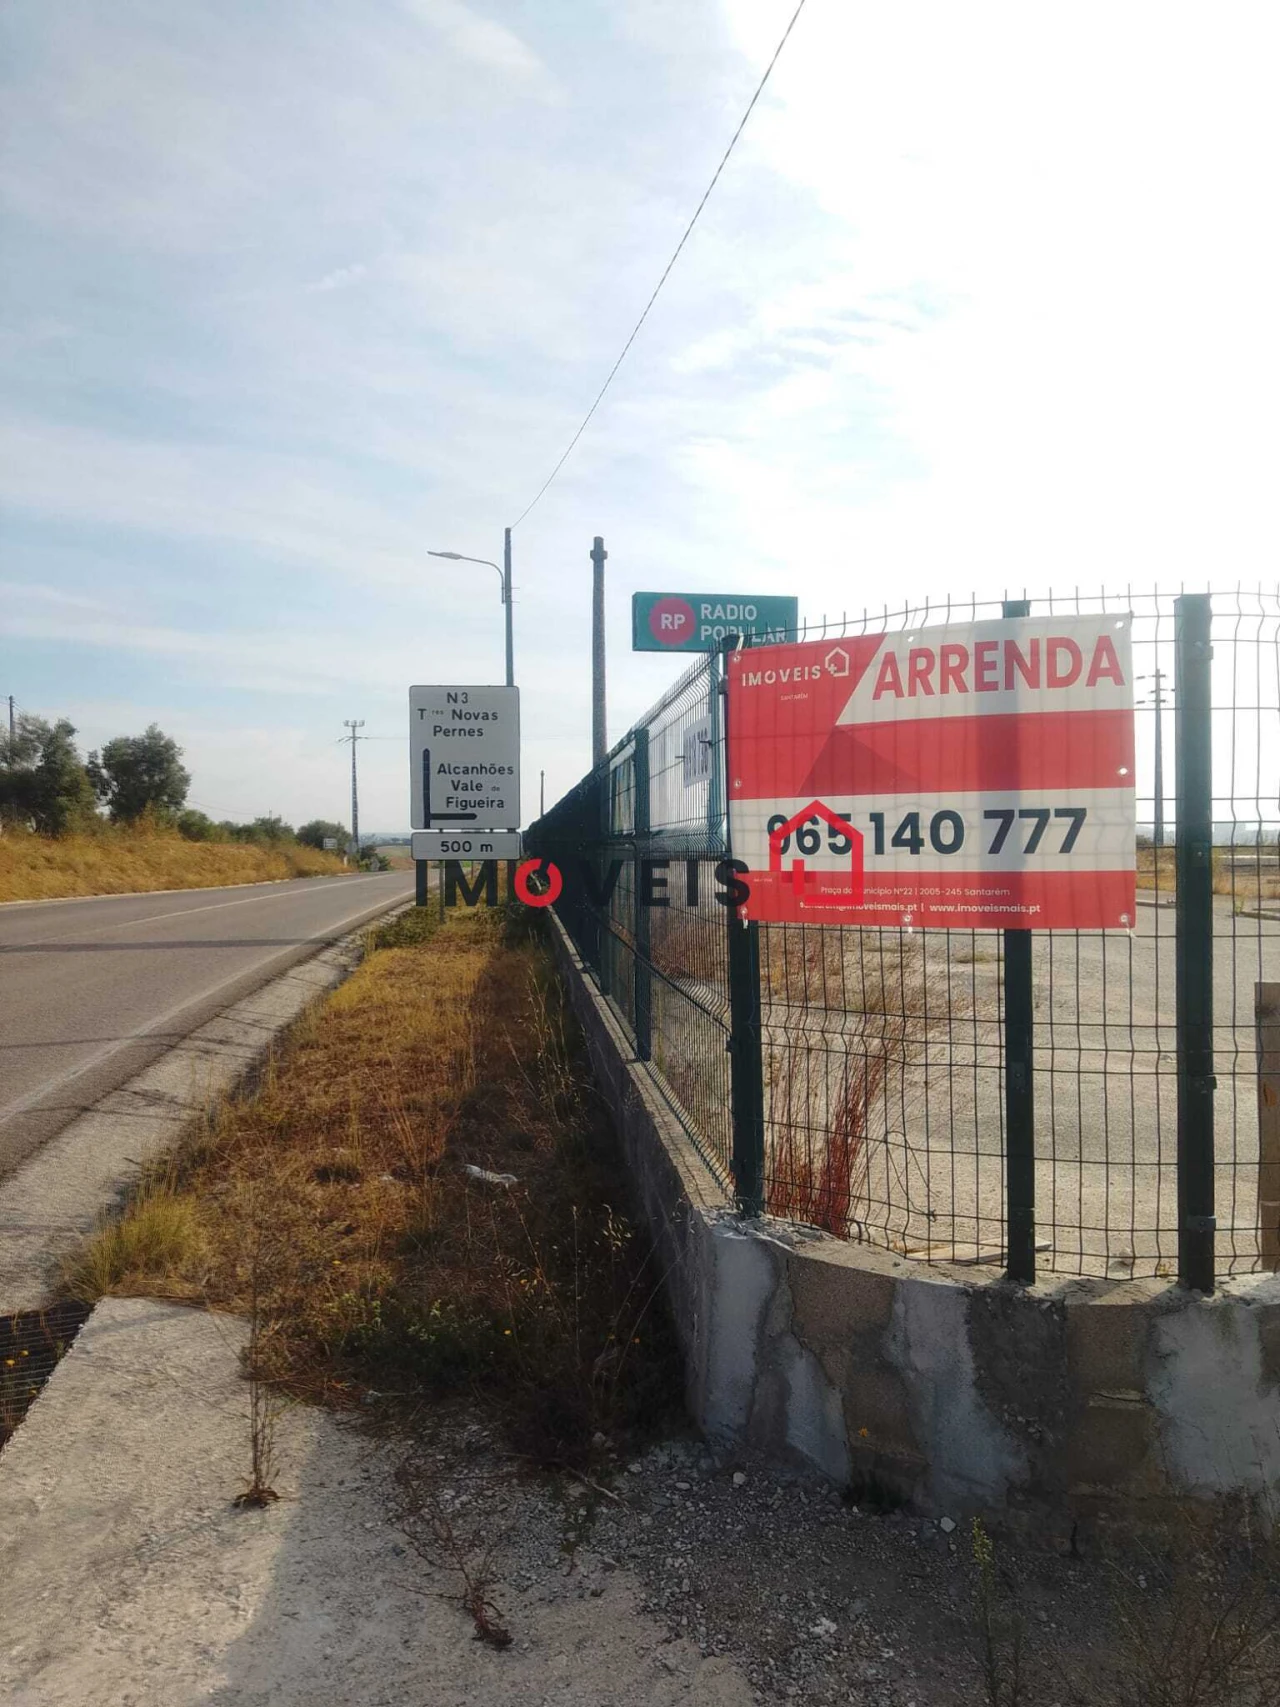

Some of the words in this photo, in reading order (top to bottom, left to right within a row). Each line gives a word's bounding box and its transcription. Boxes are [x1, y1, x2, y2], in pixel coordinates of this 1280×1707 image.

[700, 603, 758, 621] RADIO
[660, 613, 686, 630] RP
[872, 635, 1126, 701] ARRENDA
[741, 665, 821, 687] IMOVEIS
[451, 708, 499, 721] Novas
[433, 724, 484, 737] Pernes
[436, 762, 514, 775] Alcanhões
[451, 779, 484, 792] Vale
[445, 796, 505, 811] Figueira
[766, 813, 854, 856] 965
[869, 809, 965, 856] 140
[983, 807, 1087, 855] 777
[440, 840, 473, 853] 500
[480, 843, 494, 853] m
[919, 887, 962, 896] 2005-245
[963, 887, 1011, 896] Santarém
[929, 903, 1041, 915] www.imoveismais.pt
